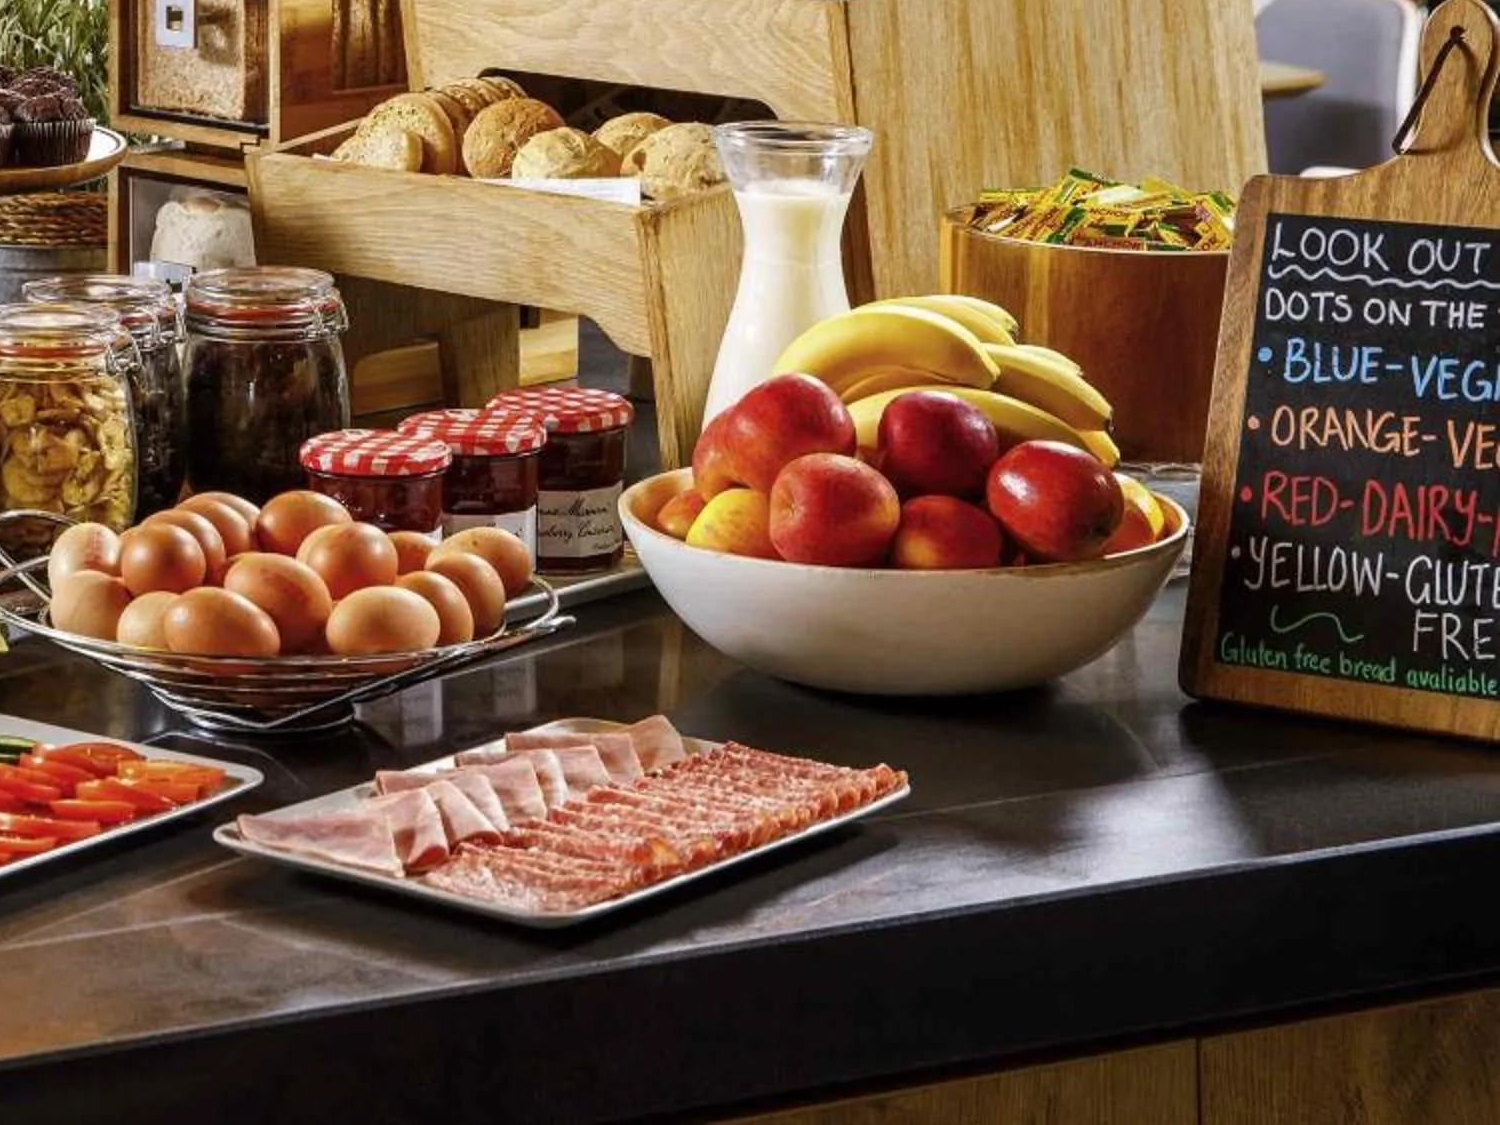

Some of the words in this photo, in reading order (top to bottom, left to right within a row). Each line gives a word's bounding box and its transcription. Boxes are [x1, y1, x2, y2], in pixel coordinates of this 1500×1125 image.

[1270, 222, 1390, 272] LOOK
[1407, 238, 1492, 275] OUT
[1265, 287, 1353, 323] DOTS
[1363, 298, 1413, 326] ON
[1420, 299, 1488, 329] THE
[1282, 336, 1500, 403] BLUE-VEG
[1270, 404, 1500, 471] ORANGE-VE
[1220, 631, 1288, 670] Gluten
[1293, 642, 1331, 675] free
[1339, 650, 1396, 683] bread
